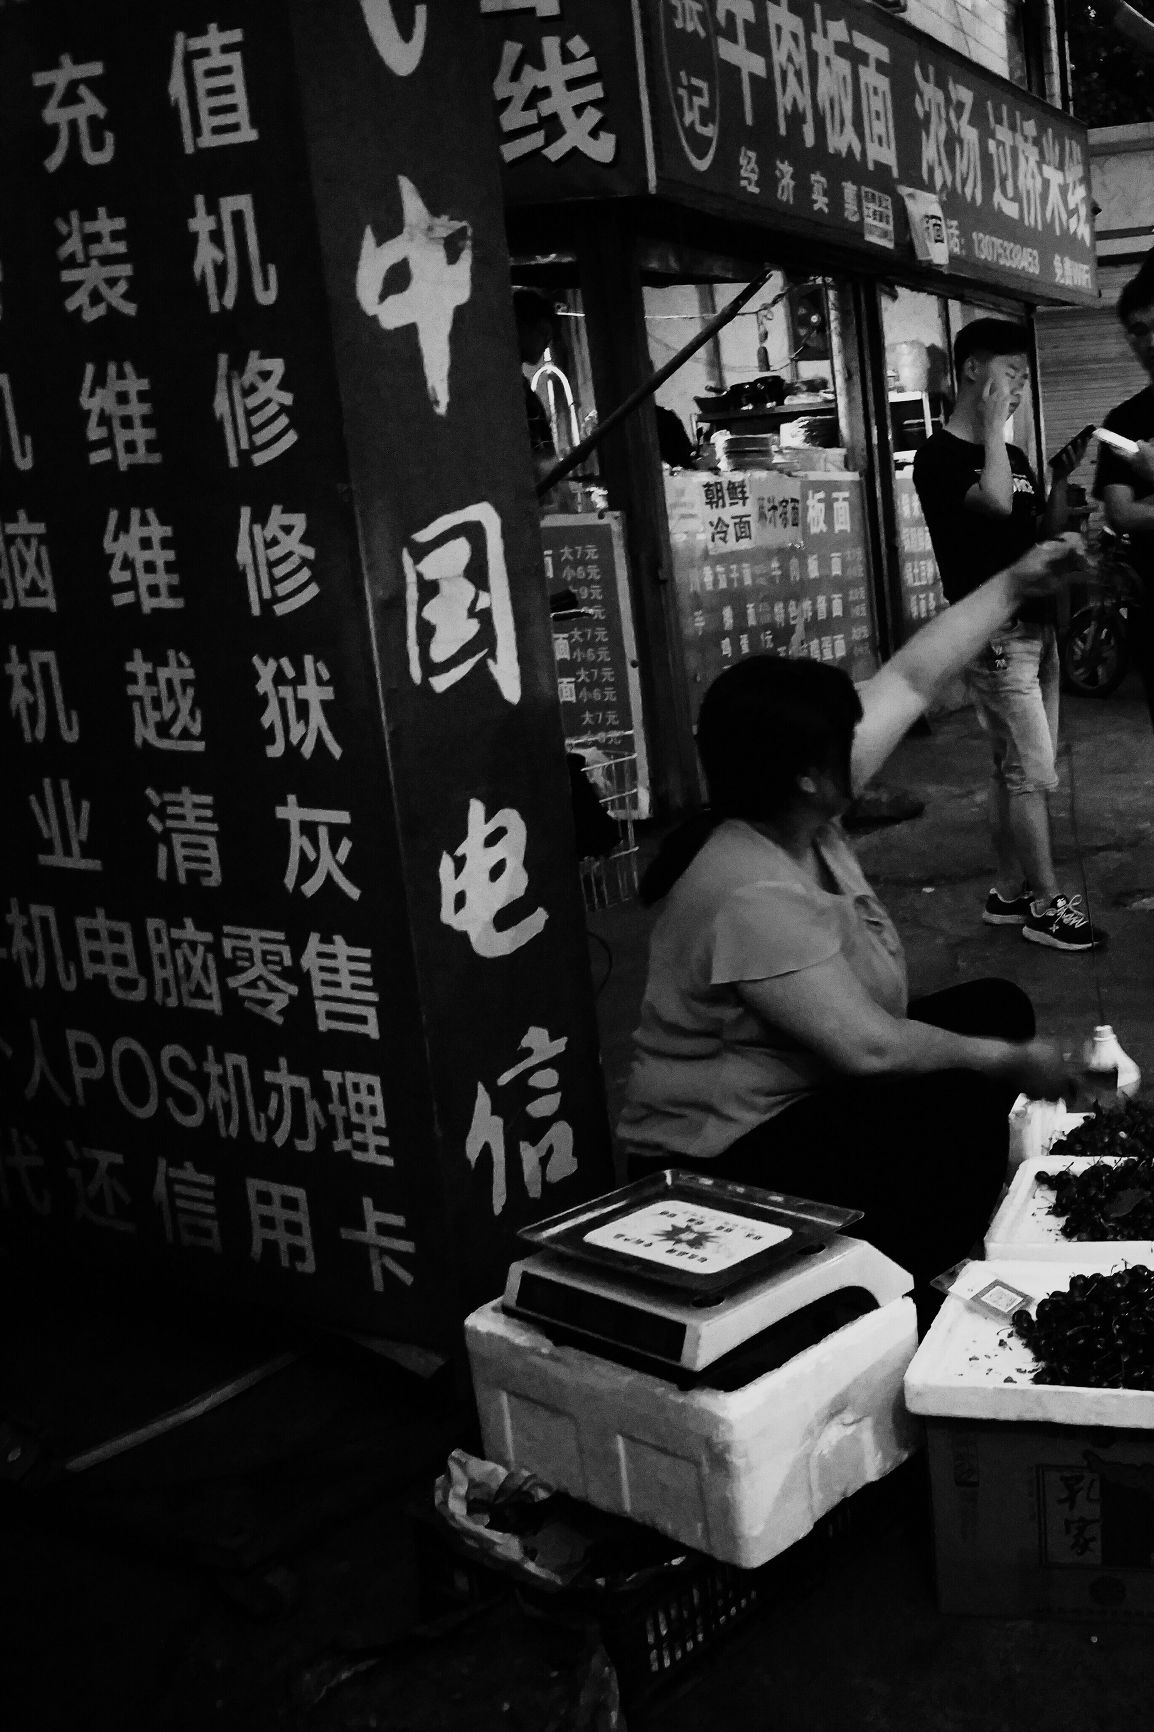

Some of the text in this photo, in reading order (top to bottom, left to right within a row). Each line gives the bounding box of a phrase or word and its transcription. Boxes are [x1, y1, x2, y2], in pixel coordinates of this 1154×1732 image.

[32, 22, 259, 174] 充值
[480, 0, 618, 164] 线
[714, 0, 900, 178] 牛肉板面
[738, 146, 862, 222] 经济实惠
[54, 193, 278, 323] 装机
[704, 479, 748, 508] 朝鲜
[709, 514, 752, 543] 冷面
[806, 490, 850, 534] 板面
[560, 544, 600, 561] 大7元
[570, 627, 609, 643] 大7元
[576, 667, 615, 683] 大7元
[4, 645, 342, 760] 机越狱
[356, 174, 579, 1216] 中国电信
[581, 710, 619, 726] 大7元
[28, 778, 361, 901] 业清灰
[0, 898, 380, 1039] 机电脑零售
[0, 1017, 395, 1167] 人POS机办理
